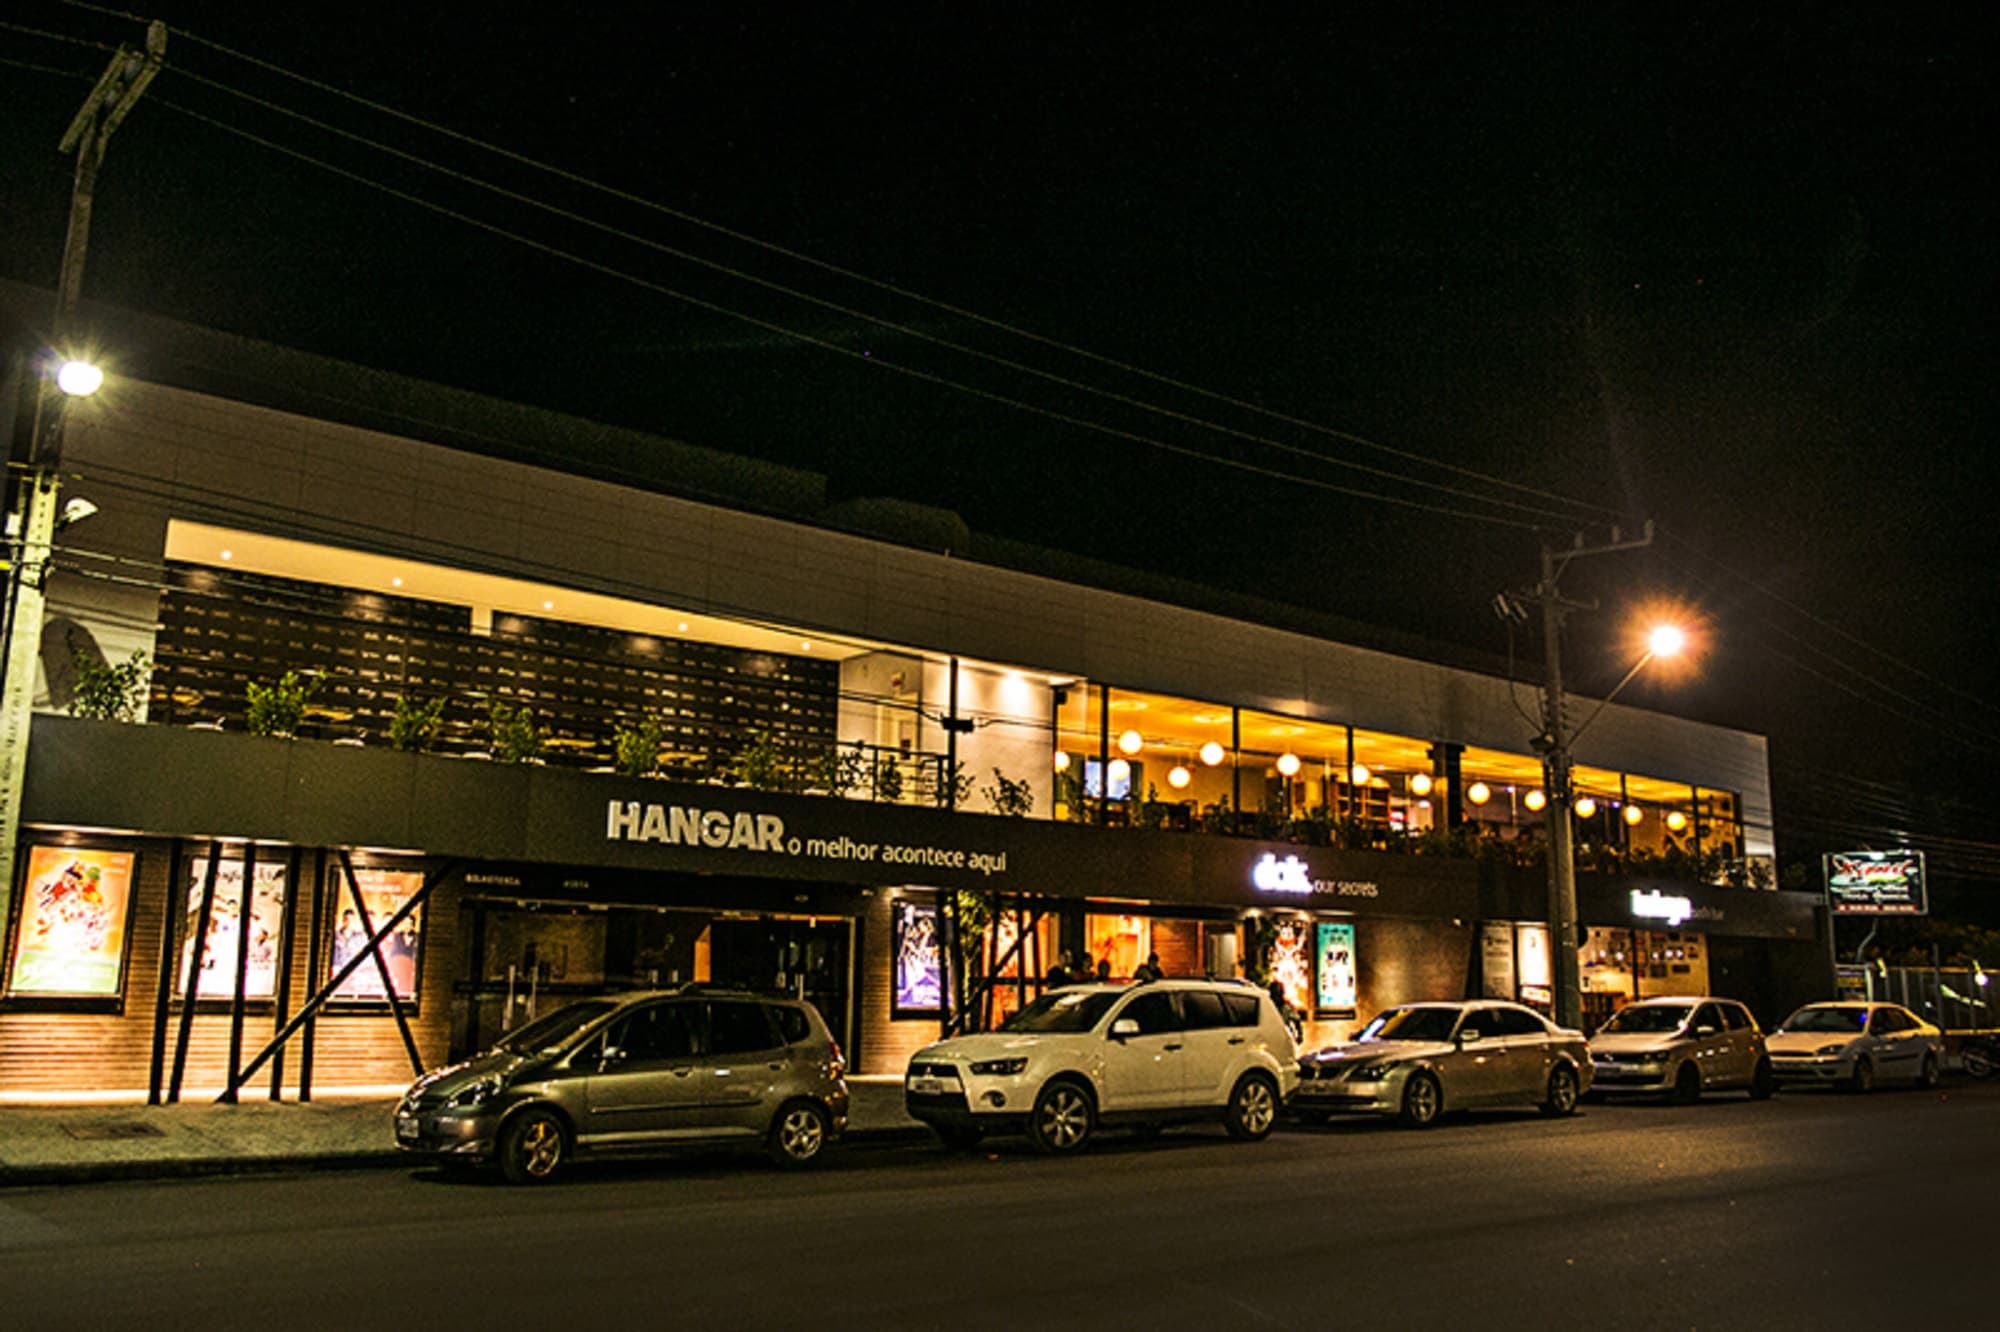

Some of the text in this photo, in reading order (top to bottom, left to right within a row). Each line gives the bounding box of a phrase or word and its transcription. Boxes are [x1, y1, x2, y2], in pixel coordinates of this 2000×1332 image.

[607, 800, 1006, 876] HANGAR o melhor acontece aqui
